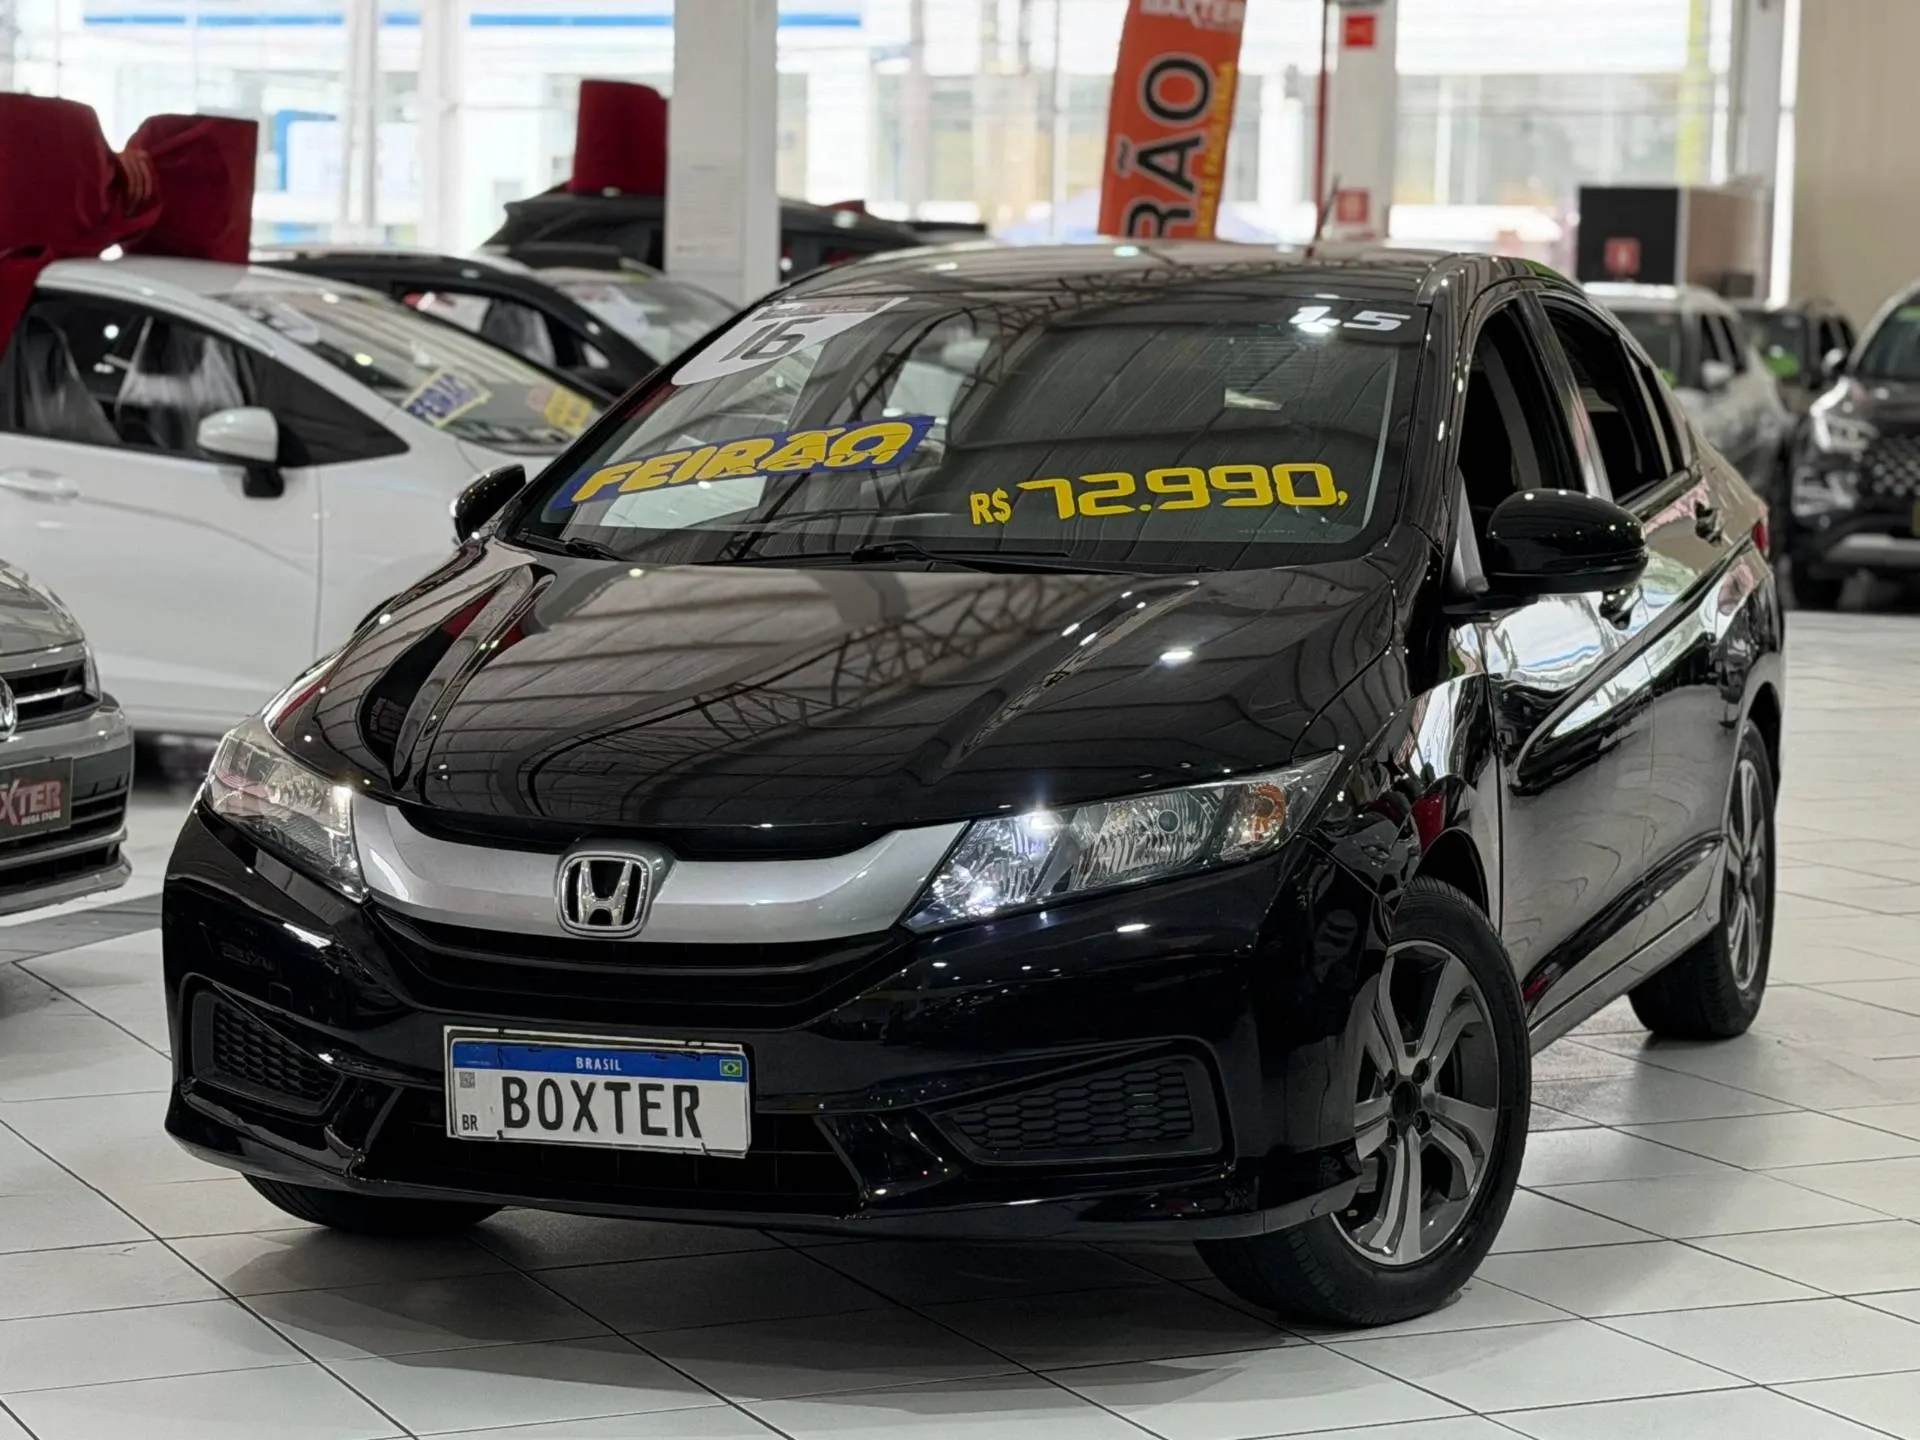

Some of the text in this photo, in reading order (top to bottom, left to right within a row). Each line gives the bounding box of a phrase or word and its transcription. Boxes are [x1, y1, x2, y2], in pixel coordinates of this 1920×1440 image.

[718, 316, 827, 364] 16
[571, 421, 914, 502] FEIRÃO
[969, 488, 1012, 525] R$
[575, 1056, 622, 1072] BRASIL
[461, 1114, 479, 1132] BR
[501, 1075, 702, 1139] BOXTER
